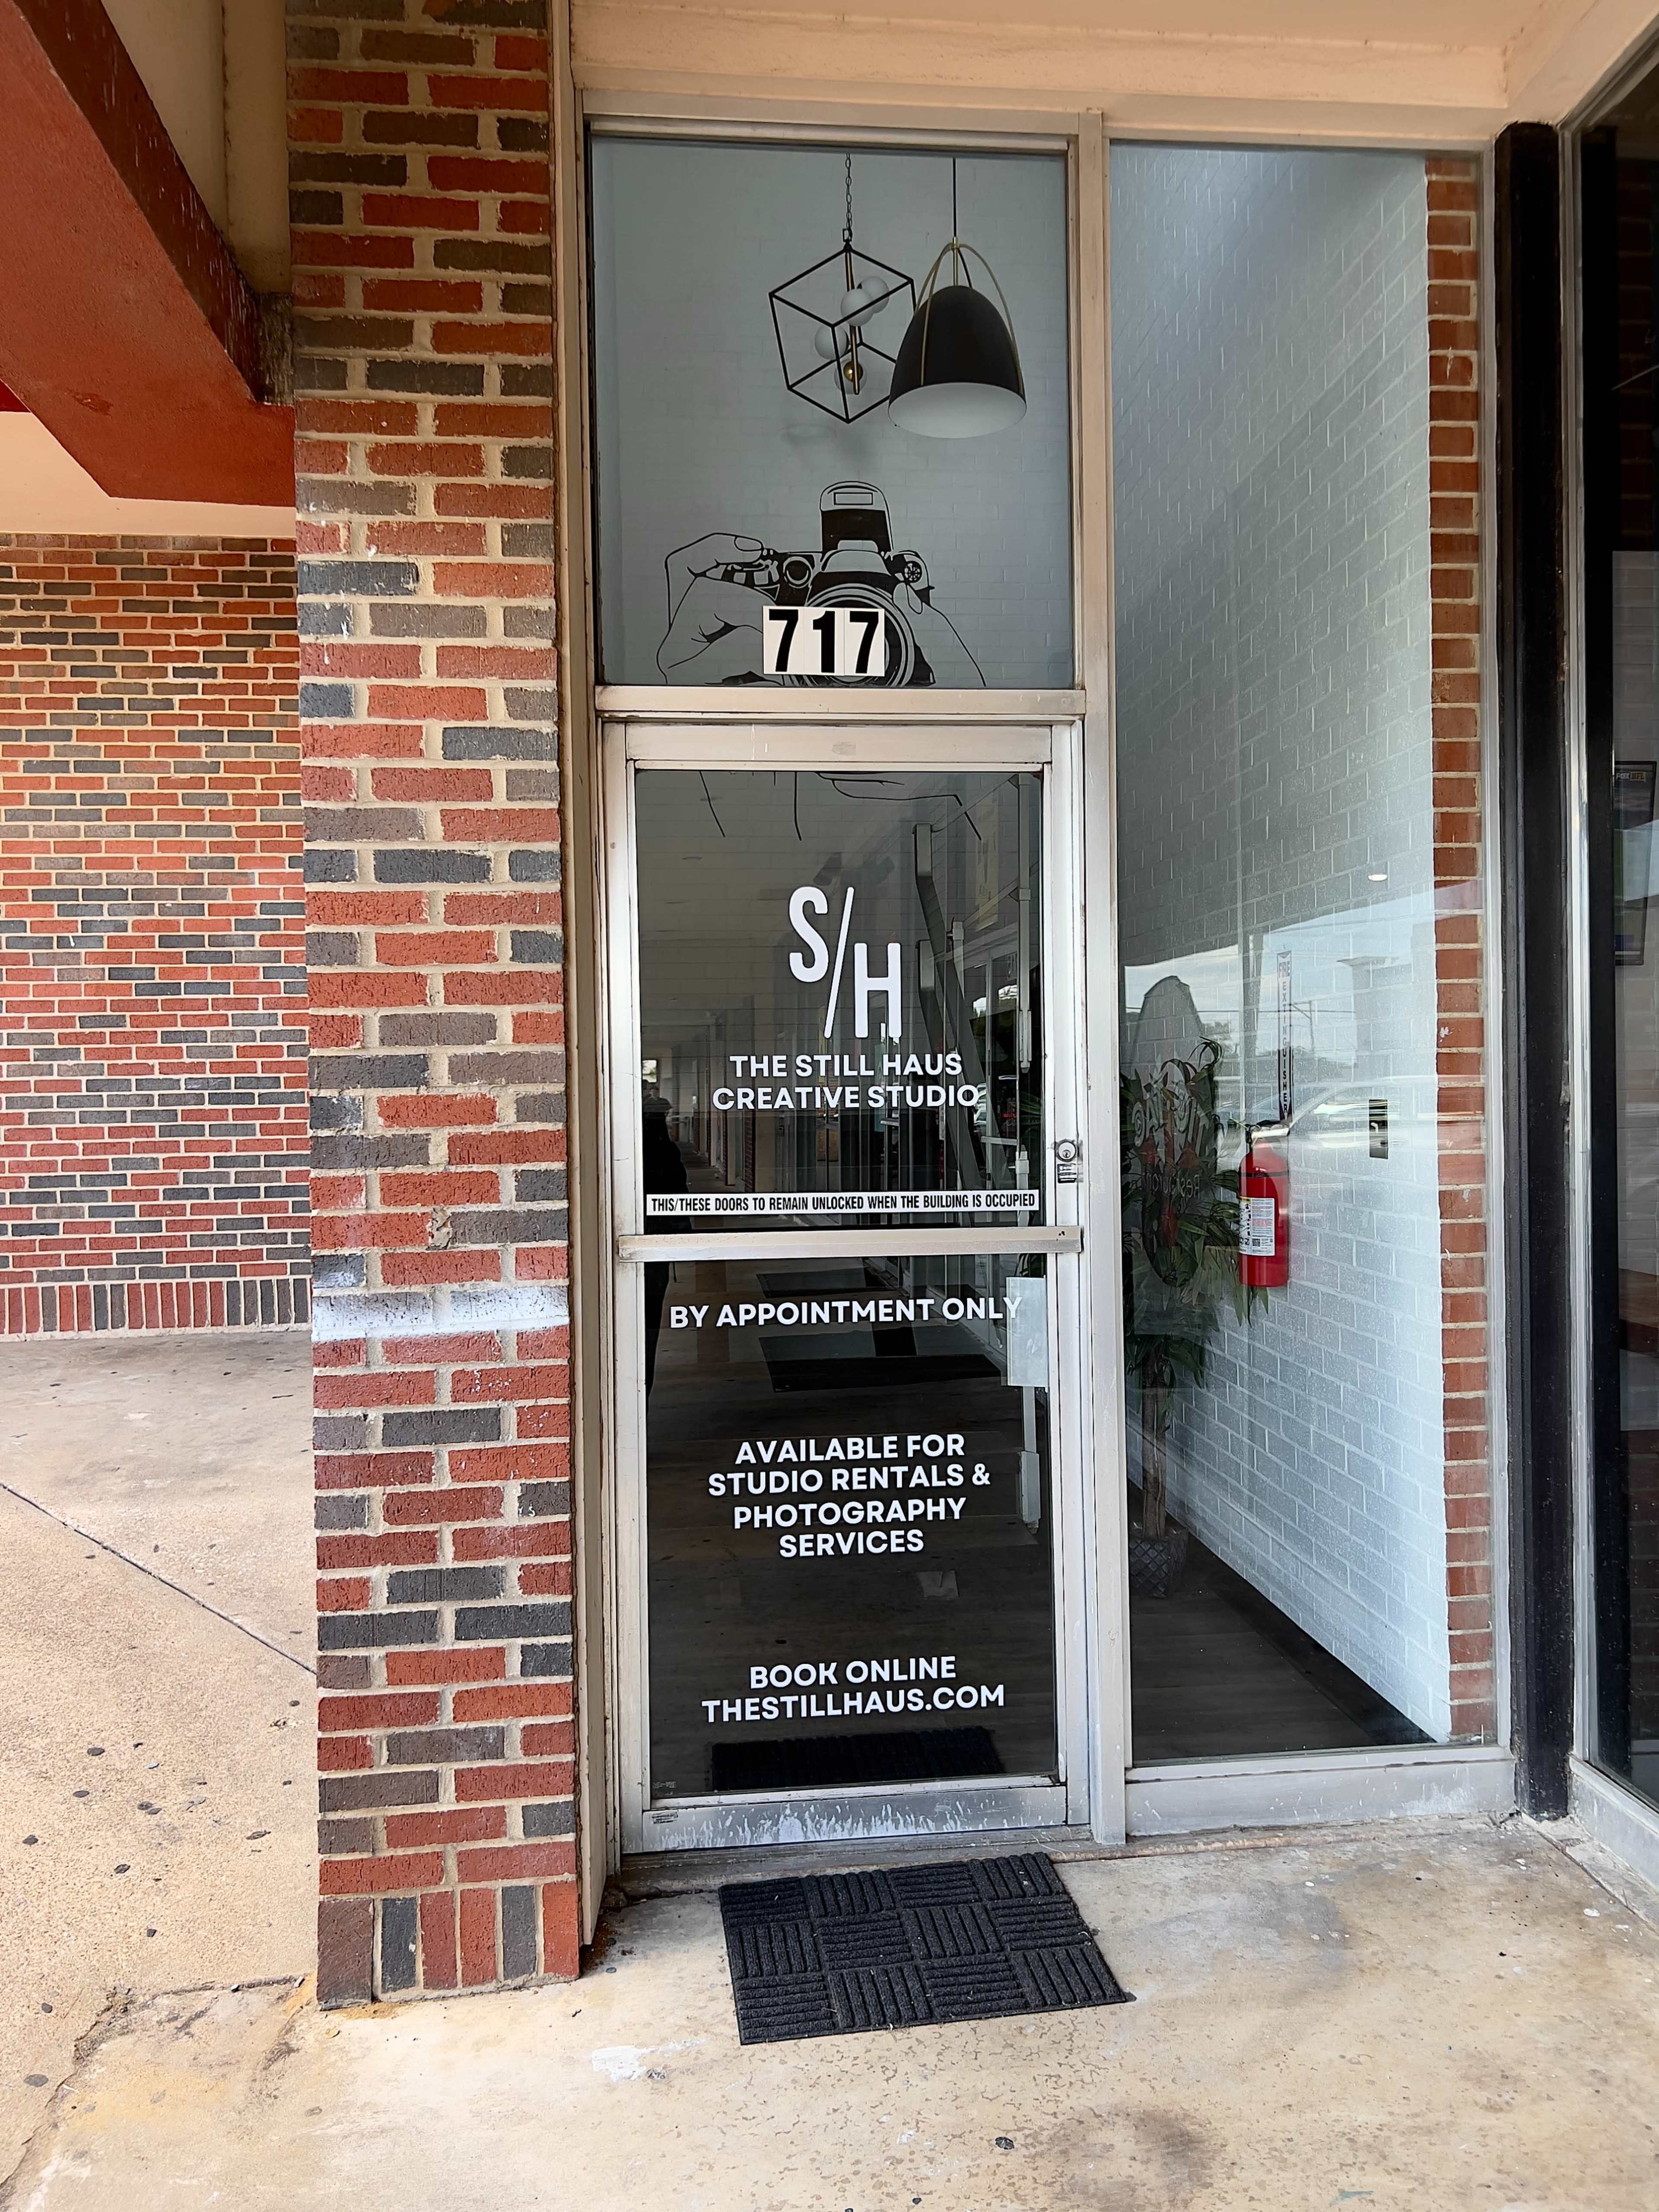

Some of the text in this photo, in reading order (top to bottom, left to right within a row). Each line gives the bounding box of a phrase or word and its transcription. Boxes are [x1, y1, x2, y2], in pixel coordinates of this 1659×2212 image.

[769, 609, 879, 674] 717
[1278, 960, 1290, 978] FIRE
[729, 1053, 962, 1077] THE STILL HAUS
[713, 1084, 979, 1110] CREATIVE STUDIO
[652, 1194, 1036, 1211] THIS/THESE DOORS TO REMAIN UNLOCKED WHEN THE BUILDING IS OCCUPIED
[671, 1297, 1022, 1328] BY APPOINTMENT ONLY
[735, 1433, 965, 1465] AVAILABLE FOR
[708, 1463, 991, 1496] STUDIO RENTALS &
[734, 1497, 966, 1529] PHOTOGRAPHY
[779, 1529, 924, 1557] SERVICES
[750, 1656, 956, 1689] BOOK ONLINE
[702, 1684, 1004, 1723] THESTILLHAUS.COM
